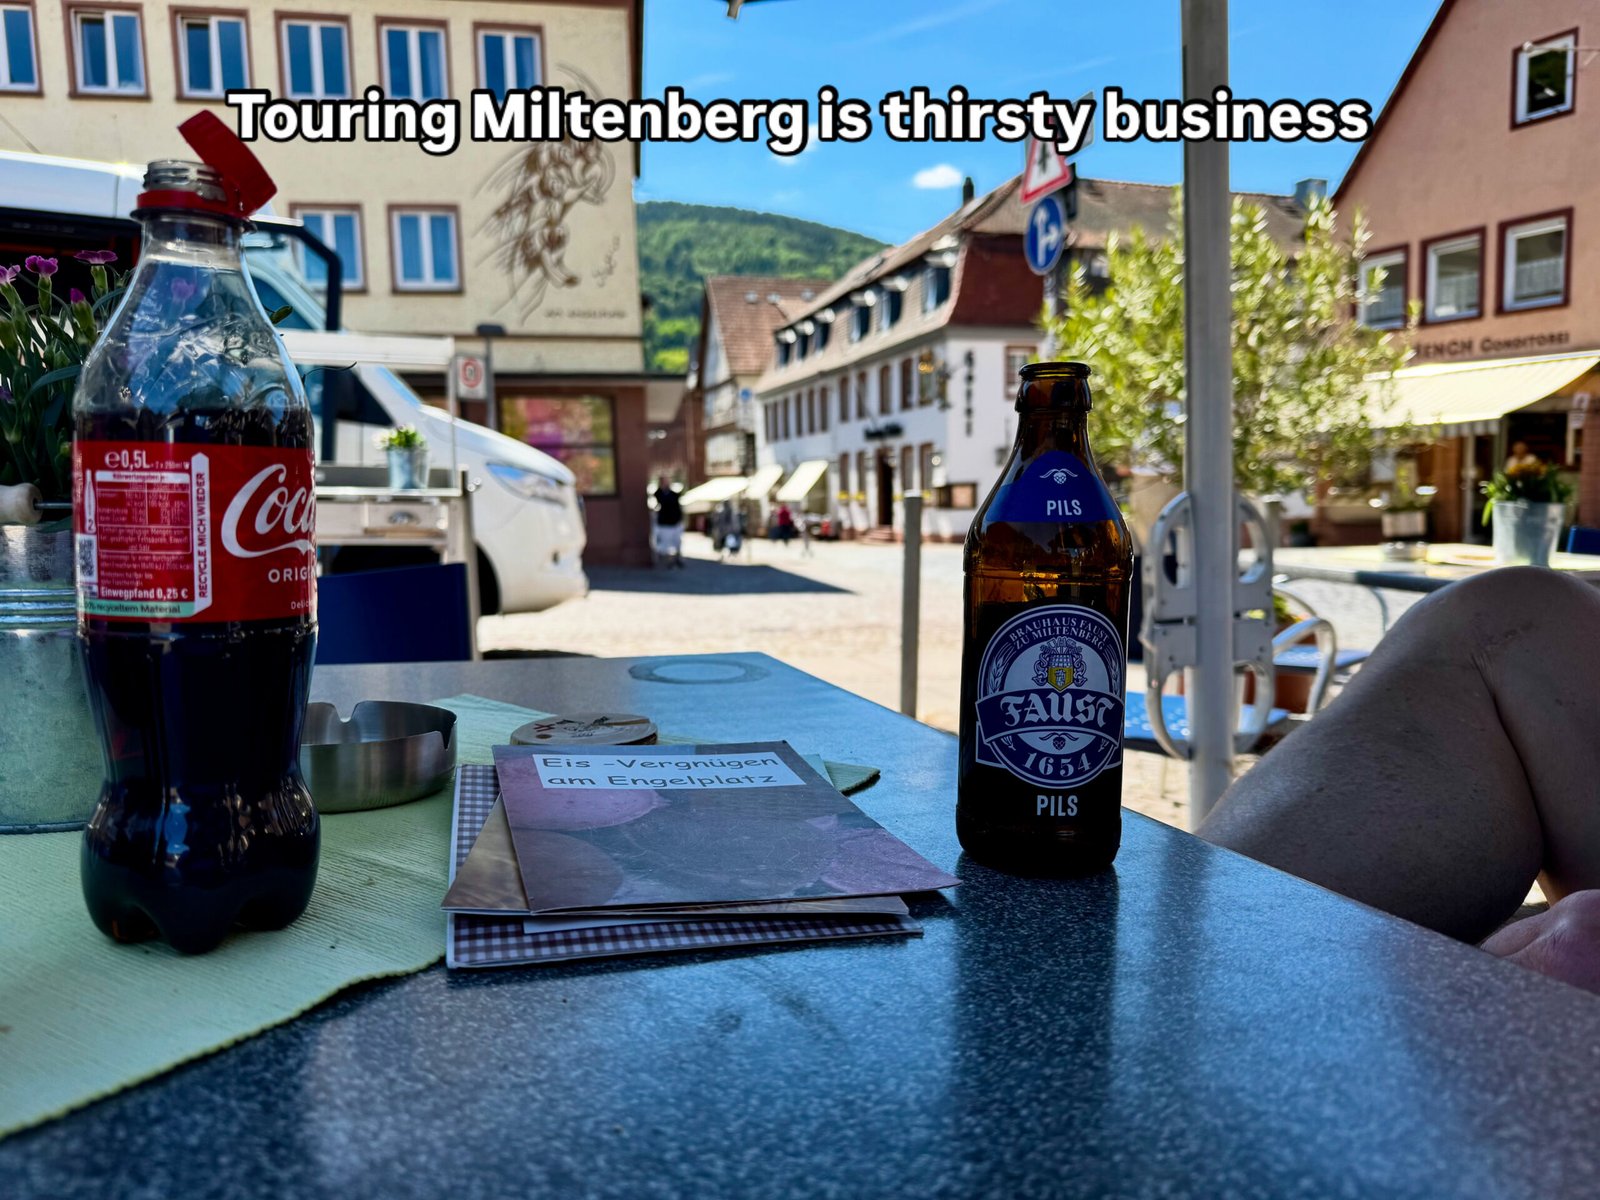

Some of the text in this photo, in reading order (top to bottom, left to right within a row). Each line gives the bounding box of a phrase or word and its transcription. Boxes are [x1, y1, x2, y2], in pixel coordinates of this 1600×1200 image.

[1046, 499, 1082, 516] PILS
[196, 472, 208, 599] RECYCLE MICH WIEDER
[268, 567, 313, 583] ORIG
[101, 586, 189, 600] Einwegpfand 0,25 €
[141, 603, 181, 614] Material
[1009, 617, 1110, 642] BRAUHAUS FAUST
[1014, 626, 1106, 650] ZU MILTENBERG
[542, 757, 591, 769] Eis
[1022, 752, 1092, 778] 1654
[547, 774, 777, 788] am Engelplatz
[1036, 794, 1079, 817] PILS
